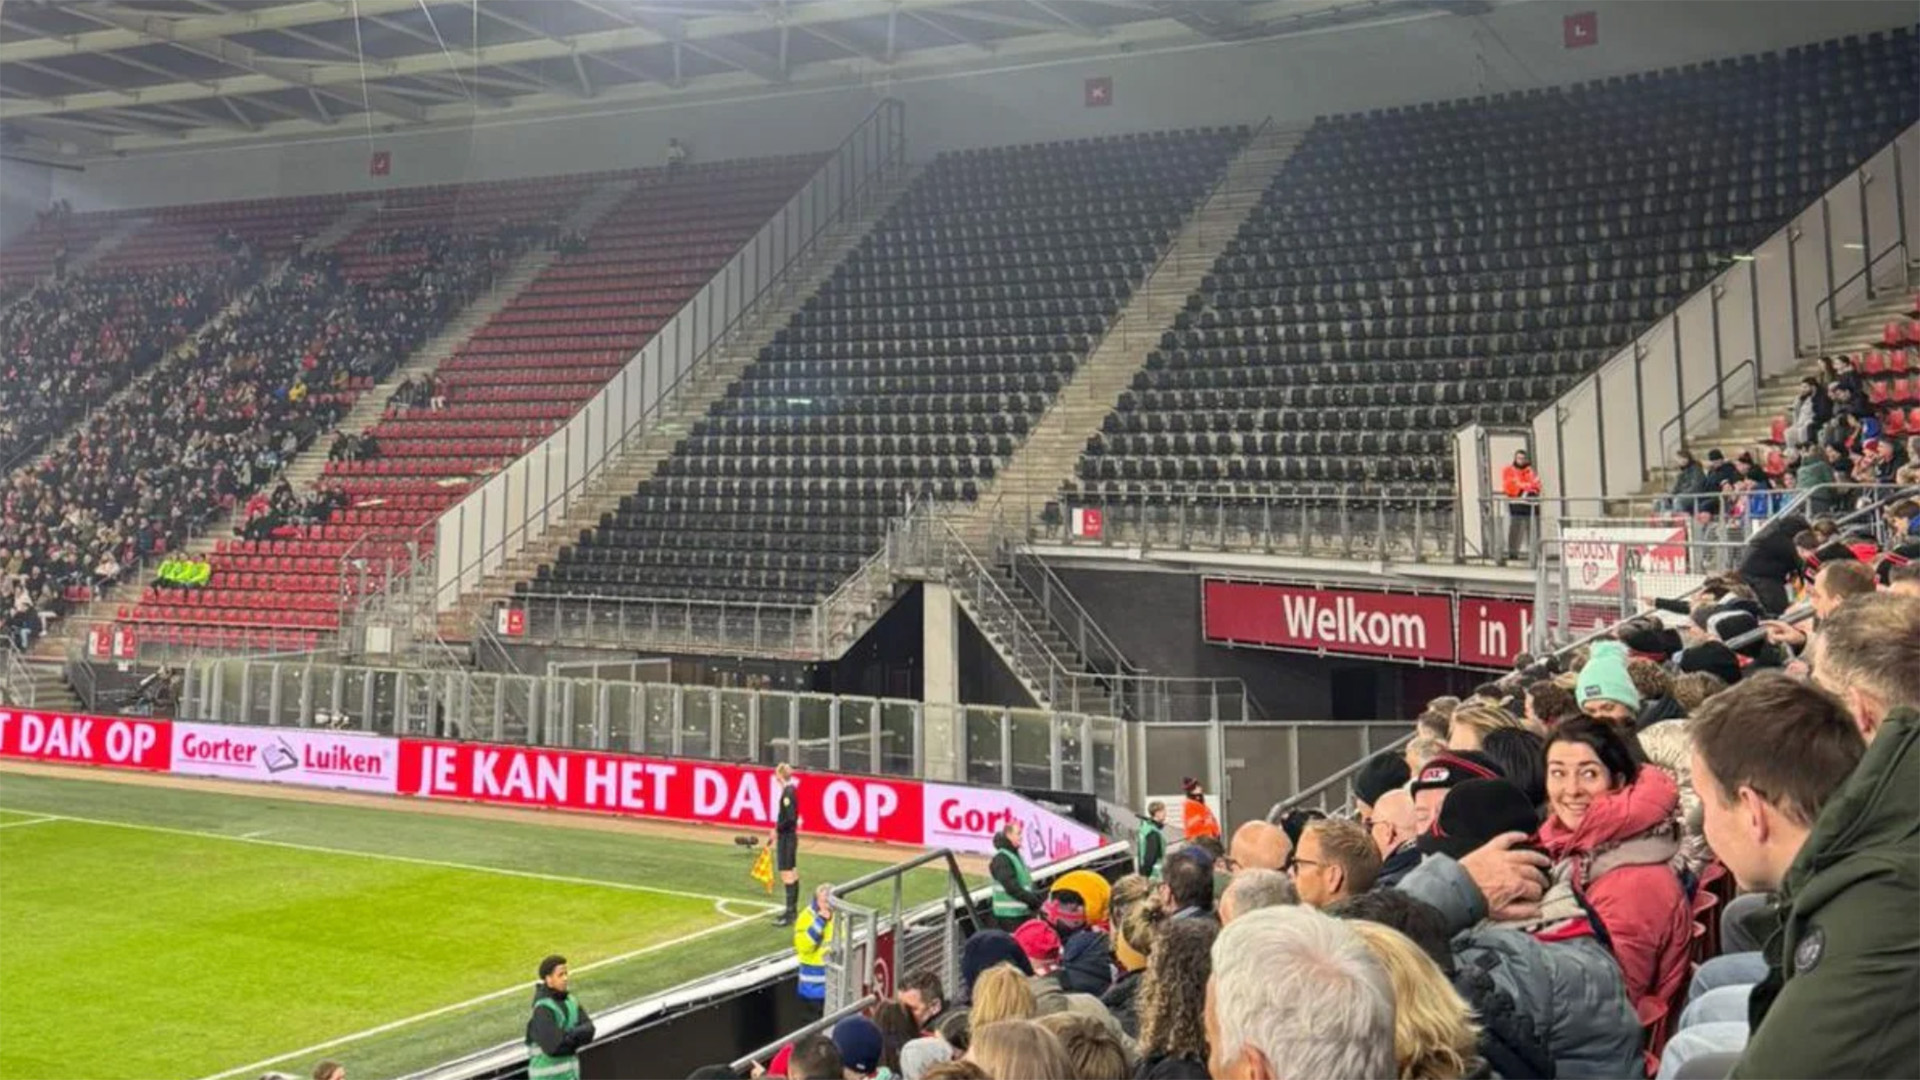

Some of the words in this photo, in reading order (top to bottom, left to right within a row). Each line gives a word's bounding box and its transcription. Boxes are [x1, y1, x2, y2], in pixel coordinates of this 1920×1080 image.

[1282, 594, 1426, 649] Welkom
[1480, 605, 1507, 659] in
[20, 713, 94, 759] DAK
[105, 720, 157, 764] OP
[182, 733, 257, 762] Gorter
[304, 743, 382, 774] Luiken
[418, 745, 457, 797] JE
[472, 749, 568, 801] KAN
[585, 758, 677, 812] HET
[822, 779, 899, 834] OP
[939, 798, 1024, 835] Gort
